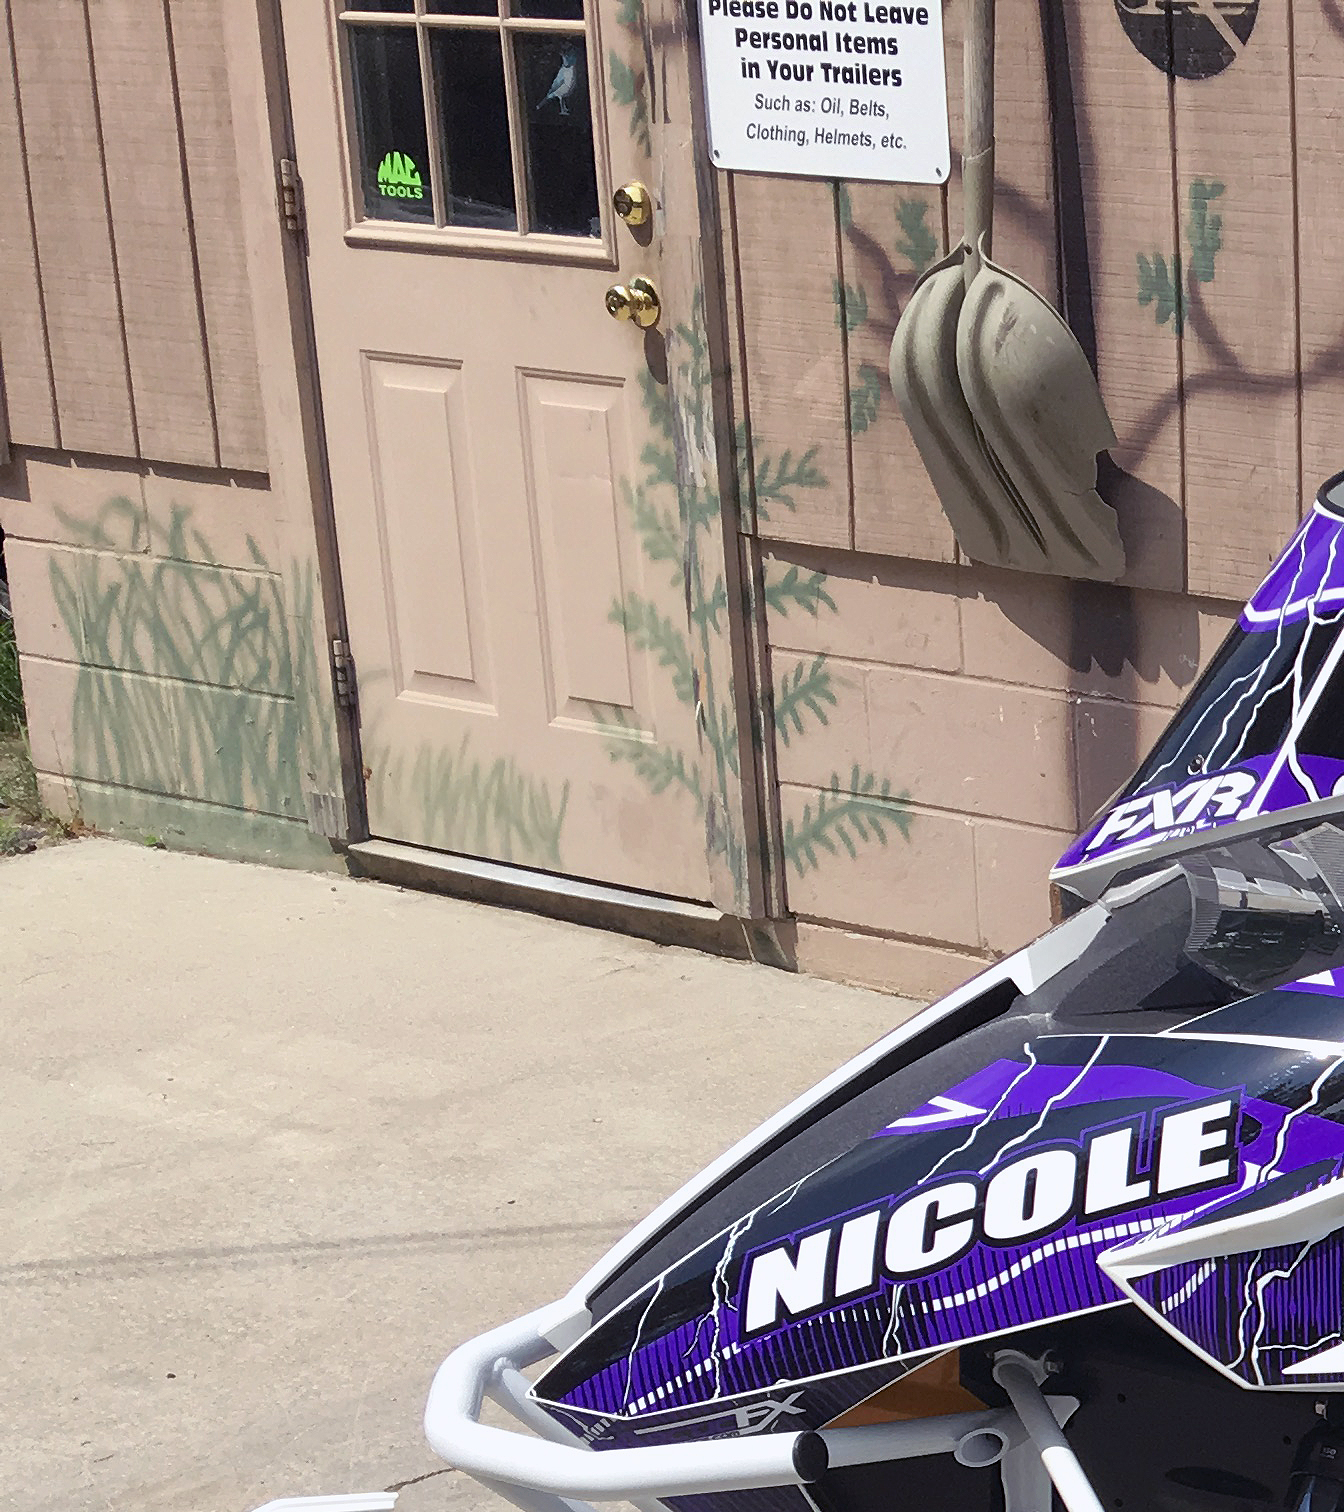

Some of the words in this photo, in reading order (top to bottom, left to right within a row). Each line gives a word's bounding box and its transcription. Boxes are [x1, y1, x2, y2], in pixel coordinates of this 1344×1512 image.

[709, 0, 778, 18] Please
[786, 0, 812, 20] Do
[820, 0, 857, 22] Not
[864, 2, 929, 25] Leave
[734, 27, 828, 52] Personal
[835, 31, 899, 56] Items
[741, 57, 760, 79] in
[767, 59, 814, 82] Your
[819, 62, 902, 87] Trailers
[755, 93, 790, 111] Such
[794, 99, 816, 113] as:
[821, 96, 844, 118] Oil,
[849, 98, 890, 120] Belts,
[746, 122, 809, 147] Clothing,
[814, 126, 876, 149] Helmets,
[880, 132, 907, 149] etc.
[378, 151, 421, 186] MAC
[379, 184, 423, 200] TOOLS
[744, 1099, 1237, 1334] NICOLE
